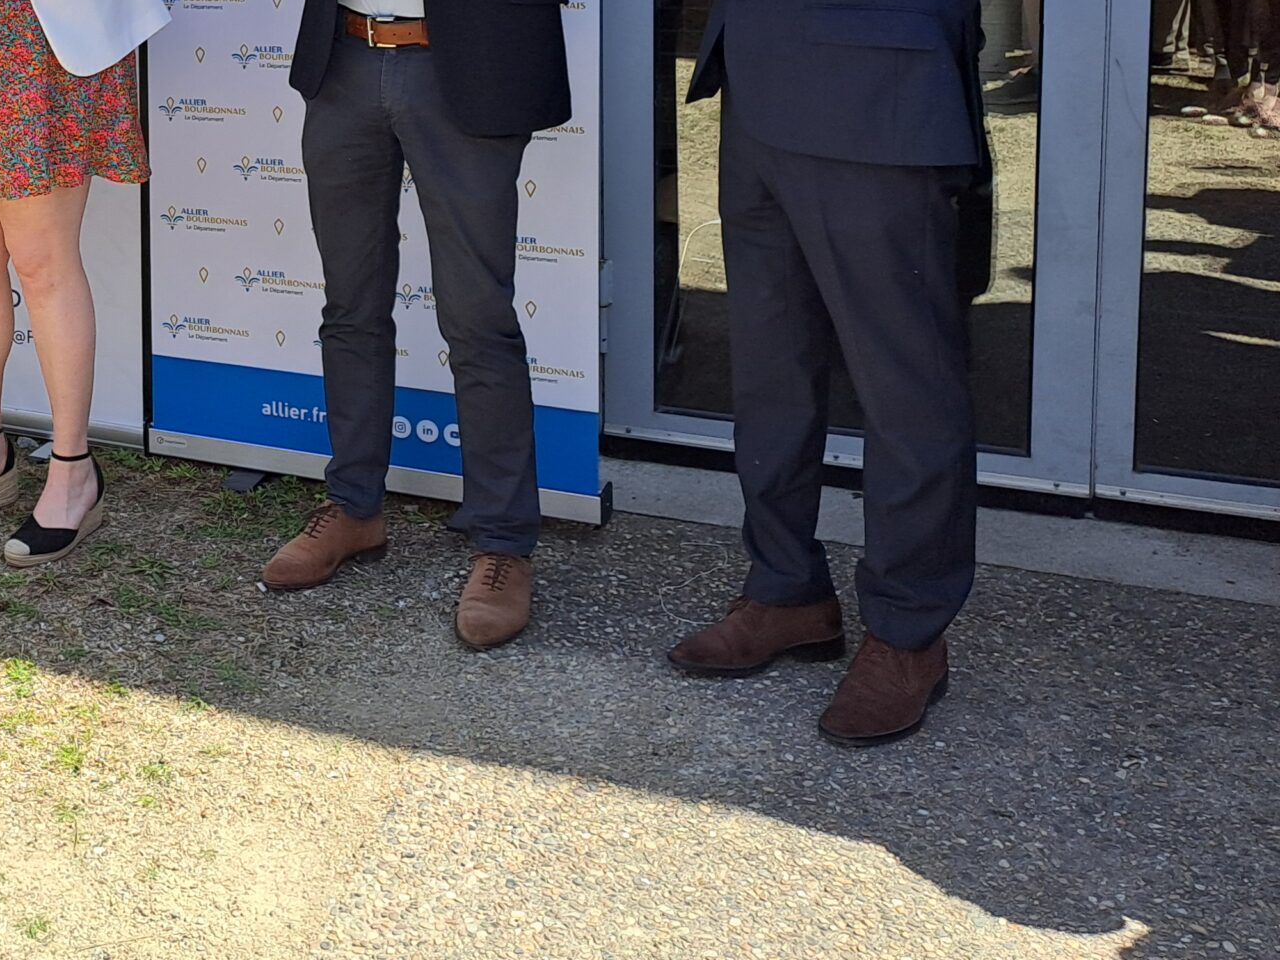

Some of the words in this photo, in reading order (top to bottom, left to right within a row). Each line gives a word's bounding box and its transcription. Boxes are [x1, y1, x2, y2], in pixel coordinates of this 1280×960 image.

[179, 98, 207, 106] ALLIER
[184, 105, 246, 115] BOURBONNAIS
[255, 158, 284, 166] ALLIER
[181, 208, 208, 216] ALLIER
[186, 215, 248, 227] BOURBONNAIS
[516, 244, 584, 257] OURBONNAIS
[257, 269, 285, 278] ALLIER
[183, 316, 210, 325] ALLIER
[188, 324, 250, 337] BOURBONNAIS
[261, 401, 327, 424] allier.fr
